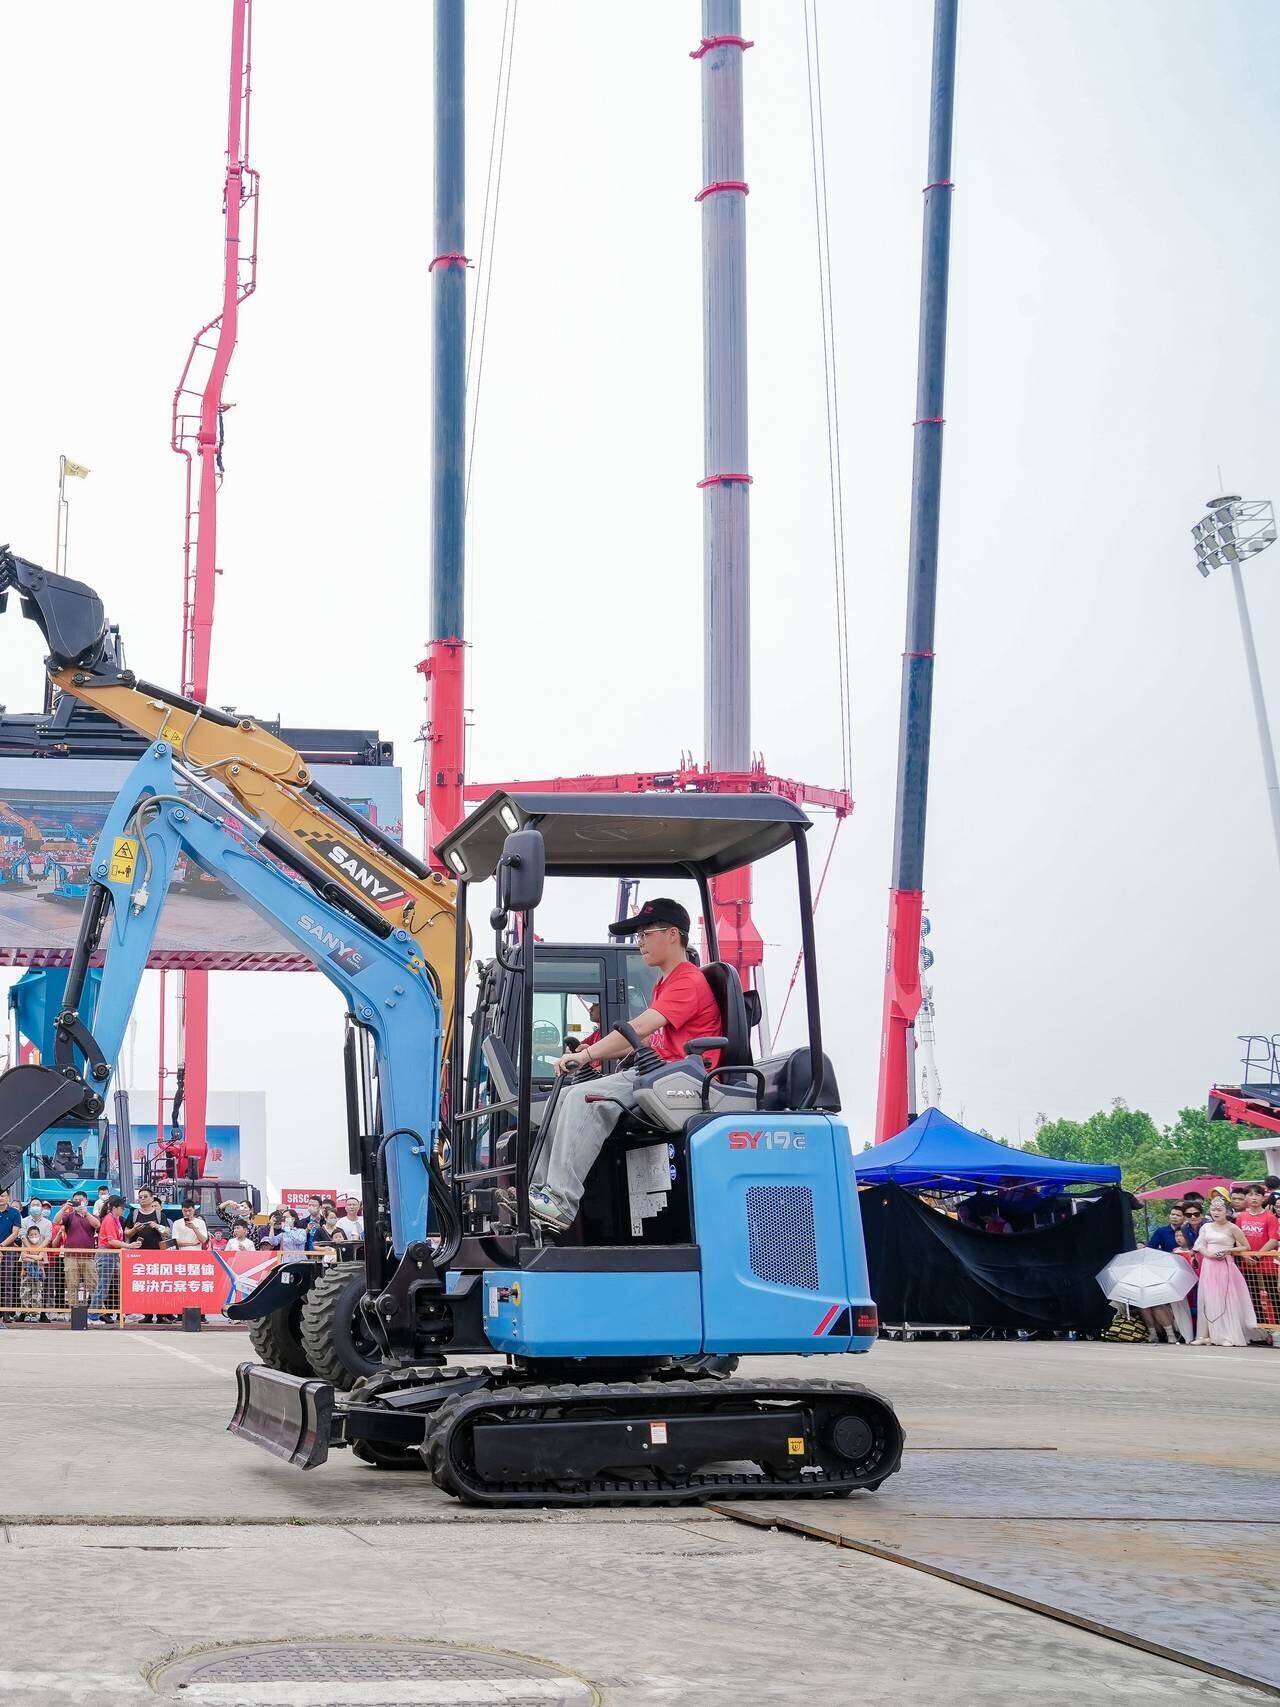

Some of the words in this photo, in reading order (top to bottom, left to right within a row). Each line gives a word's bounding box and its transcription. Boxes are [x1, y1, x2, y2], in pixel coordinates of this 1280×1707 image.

[327, 845, 389, 897] SANY
[297, 914, 348, 956] SANY
[132, 1263, 215, 1276] 全球风电整体
[132, 1280, 214, 1293] 解决方案专家
